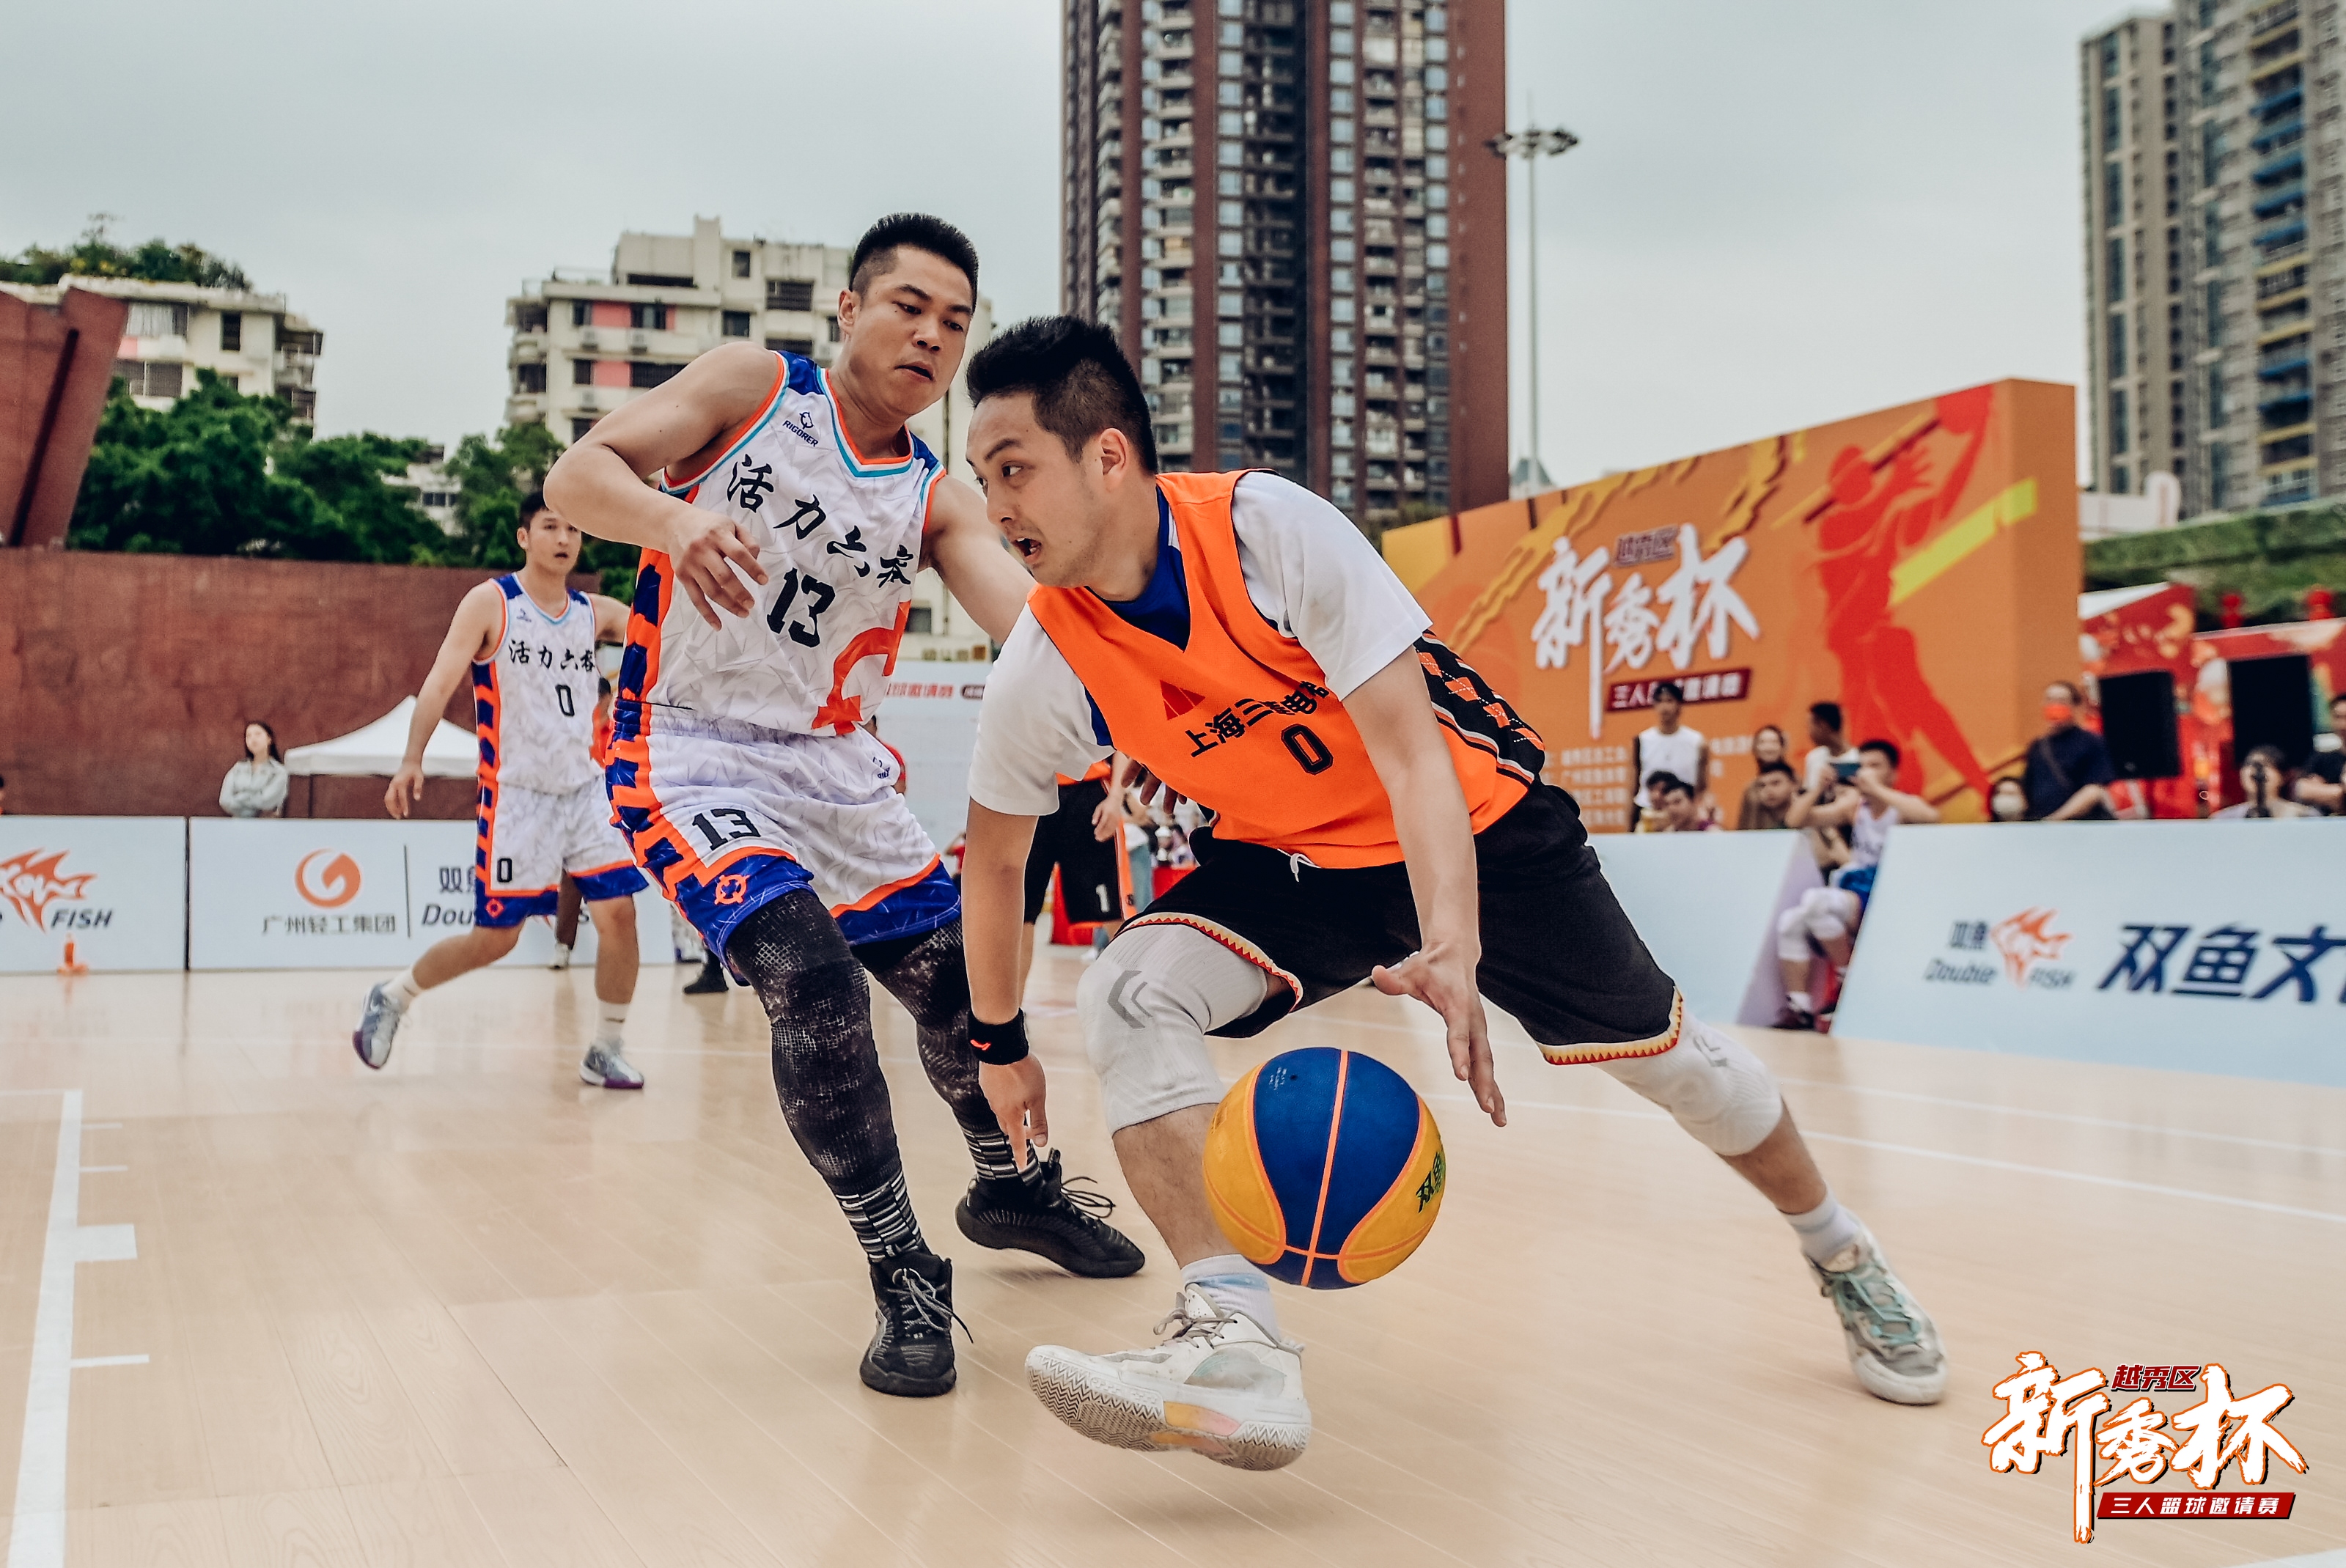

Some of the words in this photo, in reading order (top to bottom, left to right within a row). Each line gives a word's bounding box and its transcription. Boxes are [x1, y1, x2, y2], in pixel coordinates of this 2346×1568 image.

[782, 419, 819, 447] RIGORER
[767, 567, 836, 648] 13
[1531, 523, 1760, 740] 新秀杯
[555, 684, 575, 718] 0
[1612, 671, 1742, 709] 三人邀请赛
[1280, 723, 1334, 776] 0
[691, 808, 761, 851] 13
[496, 858, 512, 883] 0
[422, 903, 473, 926] Dou
[1095, 883, 1110, 913] 1
[51, 908, 113, 930] FISH
[262, 913, 397, 935] 广州轻工集团
[2096, 922, 2346, 1005] 双鱼文
